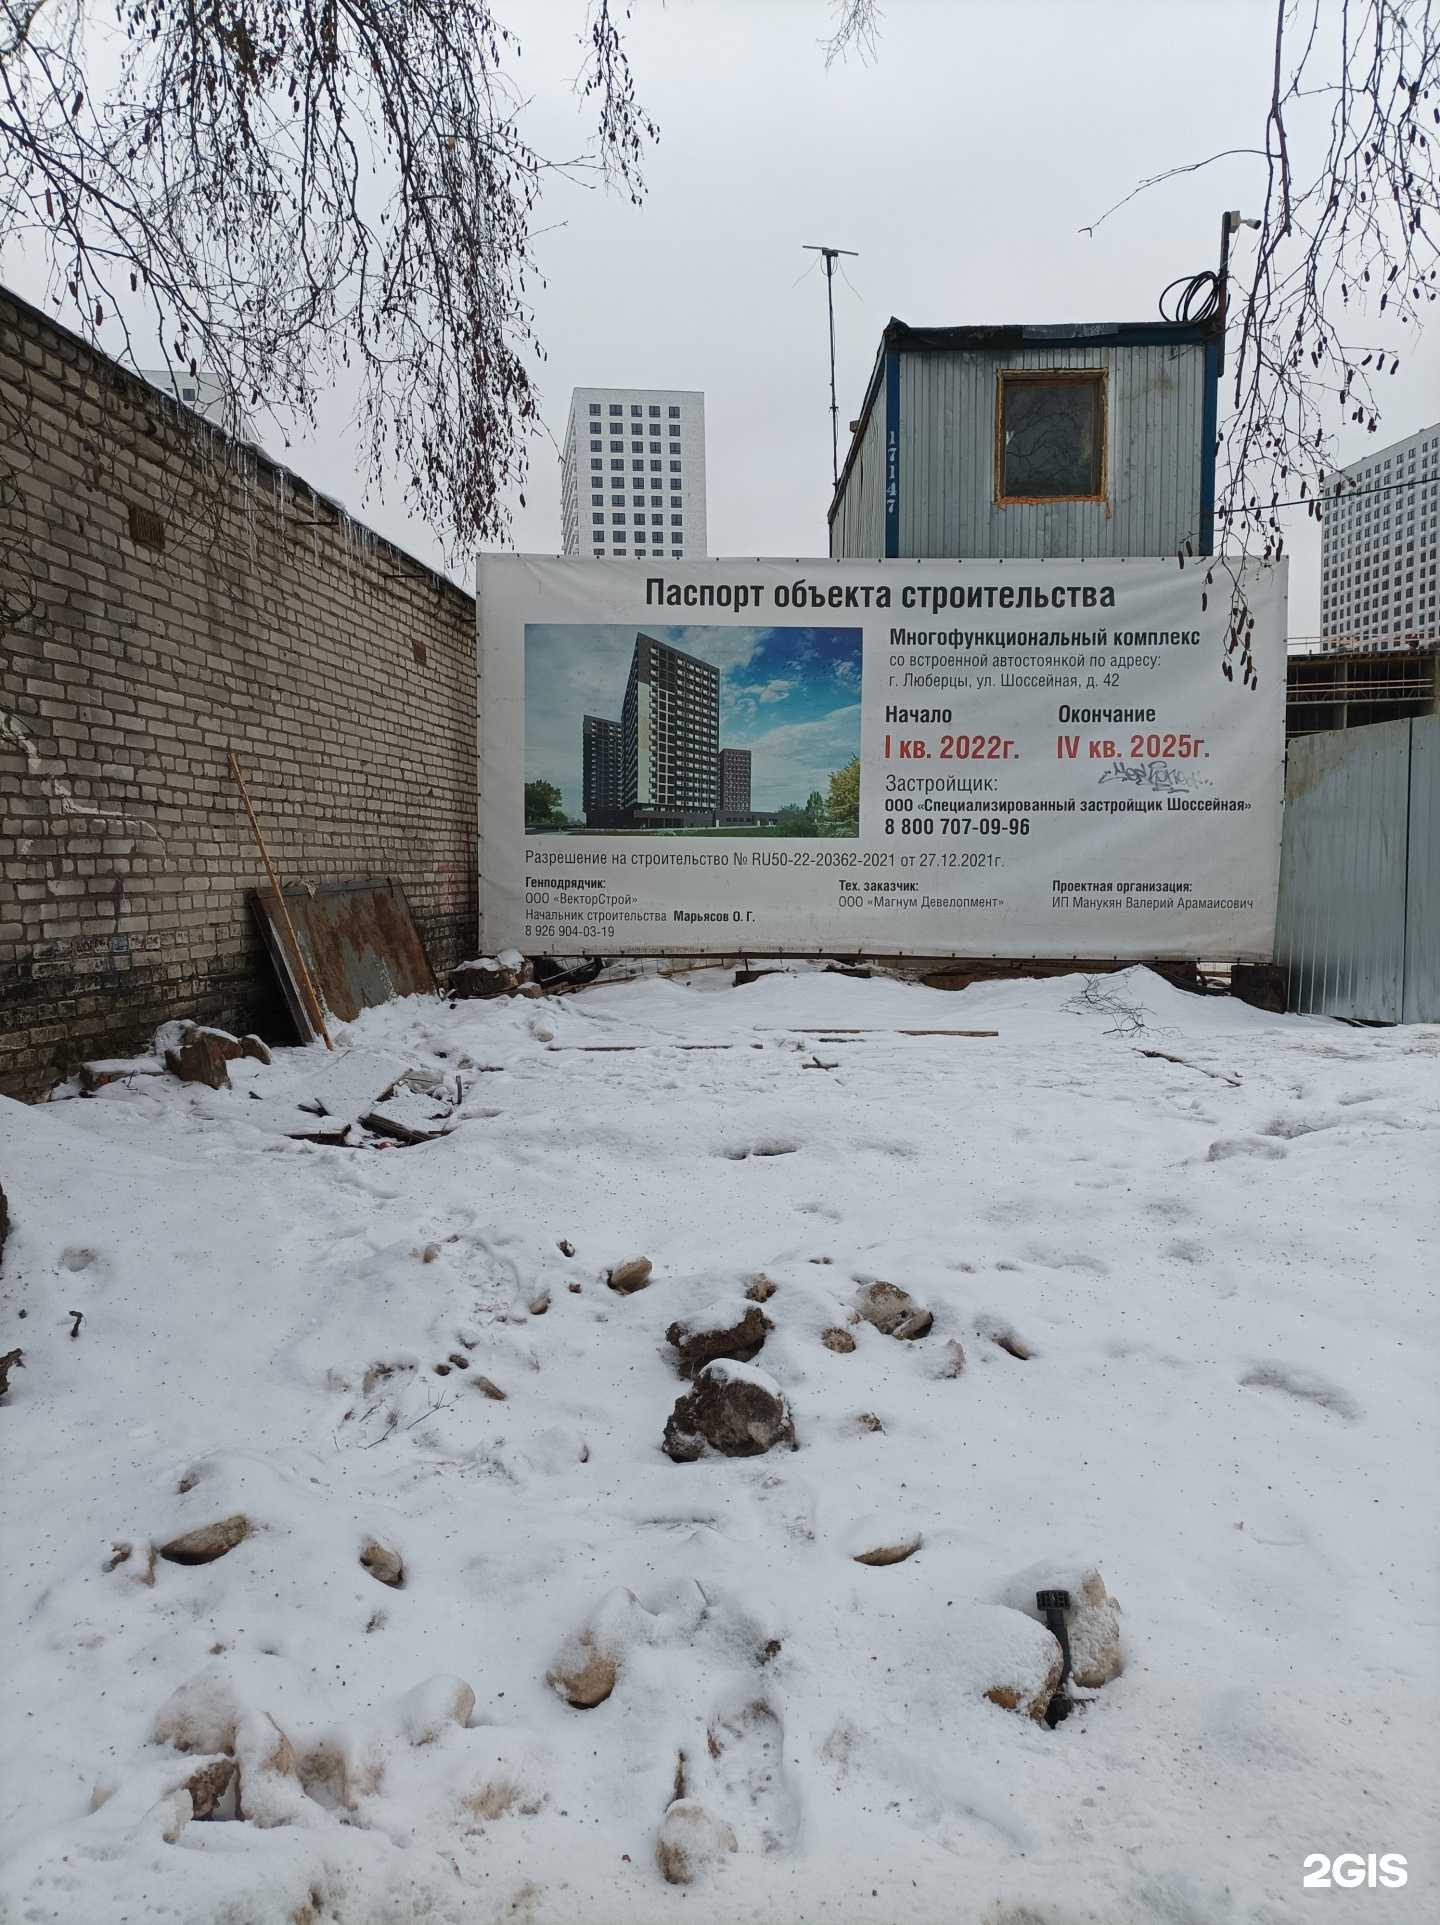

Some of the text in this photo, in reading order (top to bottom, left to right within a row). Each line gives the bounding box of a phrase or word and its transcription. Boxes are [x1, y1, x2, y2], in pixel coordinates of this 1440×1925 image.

[646, 577, 1116, 614] Паспорт объекта строительства
[889, 627, 1201, 649] Многофункциональный комплекс
[889, 653, 1161, 669] со встроенной автостоянкой по адресу:
[890, 672, 1120, 690] г. Люберцы, ул. Шоссейная, д. 42
[885, 705, 952, 723] Начало
[1058, 704, 1156, 723] Окончание
[899, 740, 932, 758] кв.
[939, 735, 1020, 759] 2022г.
[1057, 733, 1210, 758] IV кв. 2025г.
[885, 774, 998, 795] Застройщик:
[884, 797, 1252, 814] ООО «Специализированный застройщик Шоссейная»
[884, 817, 1030, 835] 8 800 707-09-96
[525, 849, 608, 866] Разрешение
[611, 853, 627, 865] на
[631, 853, 729, 868] строительство
[752, 851, 895, 866] RU50-22-20362-2021
[900, 855, 916, 868] от
[919, 852, 1005, 867] 27.12.2021г.
[525, 876, 606, 890] Генподрядчик:
[838, 879, 919, 892] Тех. заказчик:
[1052, 879, 1193, 895] Проектная организация:
[525, 891, 638, 907] ООО «ВекторСтрой»
[838, 895, 1004, 909] ООО «Магнум Девелопмент»
[1052, 896, 1069, 908] ИП
[1072, 896, 1122, 910] Манукян
[1125, 896, 1174, 911] Валерий
[525, 908, 756, 924] Начальник строительства Марьясов О. Г.
[525, 924, 615, 938] 8 926 904-03-19
